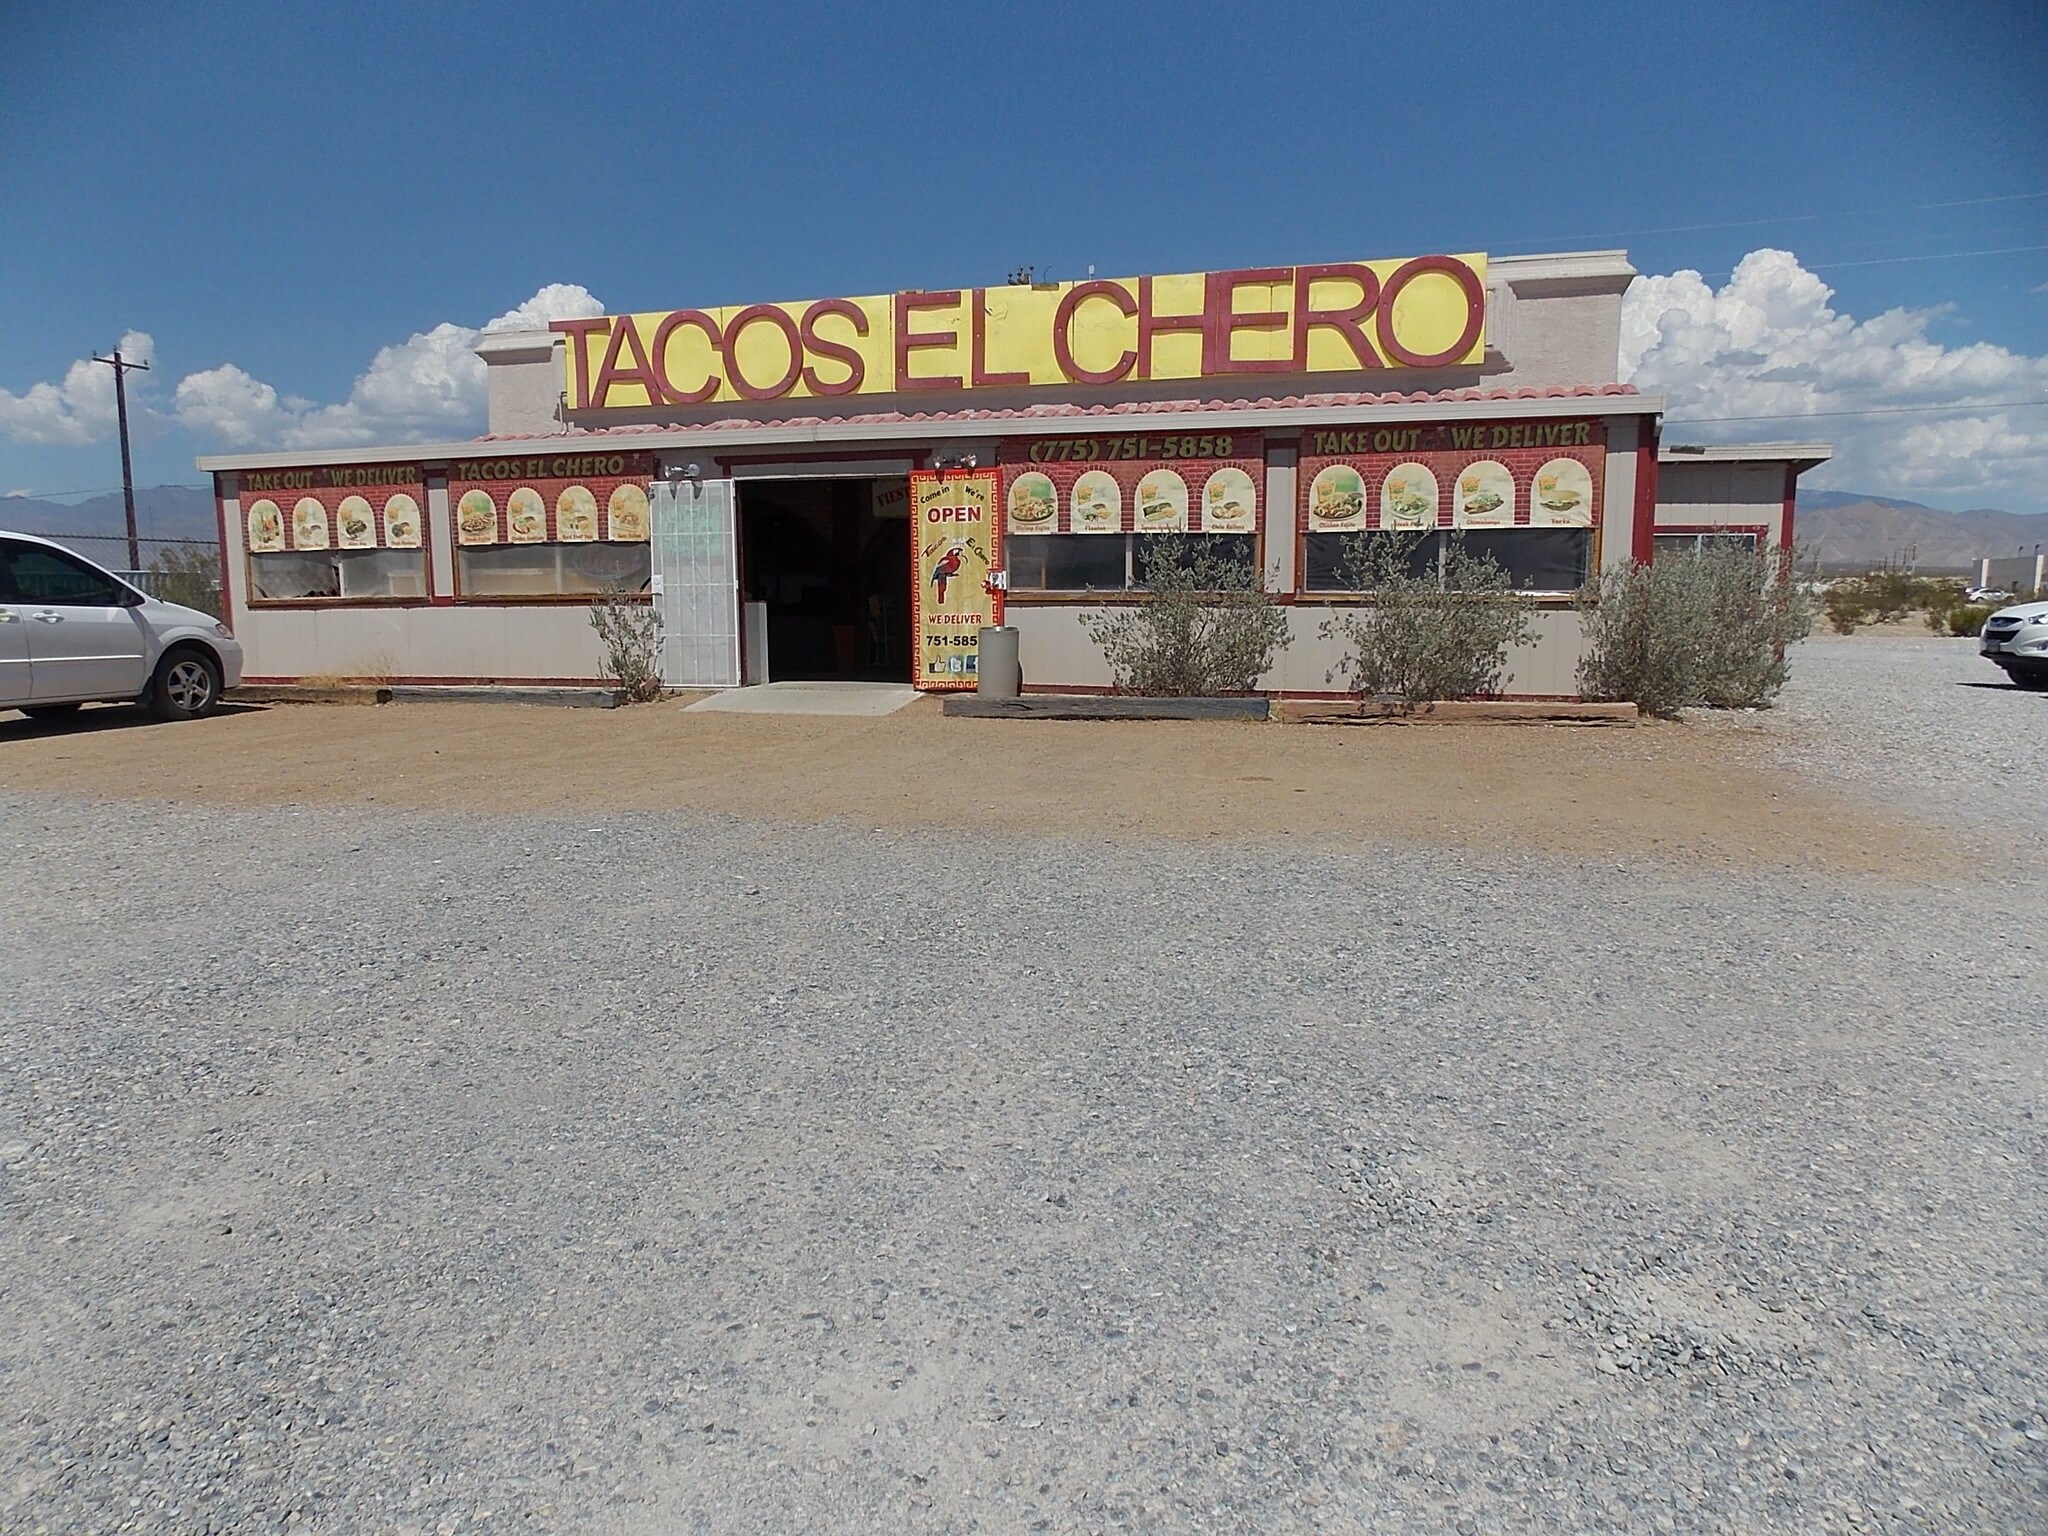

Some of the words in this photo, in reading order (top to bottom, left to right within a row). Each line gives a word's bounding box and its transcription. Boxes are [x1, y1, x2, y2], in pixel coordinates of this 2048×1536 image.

[548, 297, 869, 409] TACOS
[895, 288, 1030, 391] EL
[1053, 254, 1486, 385] CHERO
[1313, 430, 1367, 455] TAKE
[1373, 428, 1422, 452] OUT
[1451, 425, 1489, 450] WE
[1491, 422, 1591, 449] DELIVER
[1029, 439, 1099, 463] (775)
[1107, 435, 1233, 461] 751-5858
[330, 468, 349, 488] WE
[356, 465, 417, 487] DELIVER
[458, 460, 521, 481] TACOS
[526, 458, 549, 479] EL
[552, 455, 625, 478] CHERO
[246, 472, 280, 491] TAKE
[283, 470, 314, 489] OUT
[920, 490, 942, 504] Come
[941, 486, 950, 495] in
[964, 485, 985, 501] We're
[927, 506, 981, 522] OPEN
[921, 536, 947, 558] Tacos
[973, 545, 990, 565] Chero
[928, 614, 943, 624] WE
[944, 614, 982, 624] DELIVER
[926, 635, 978, 646] 751-585
